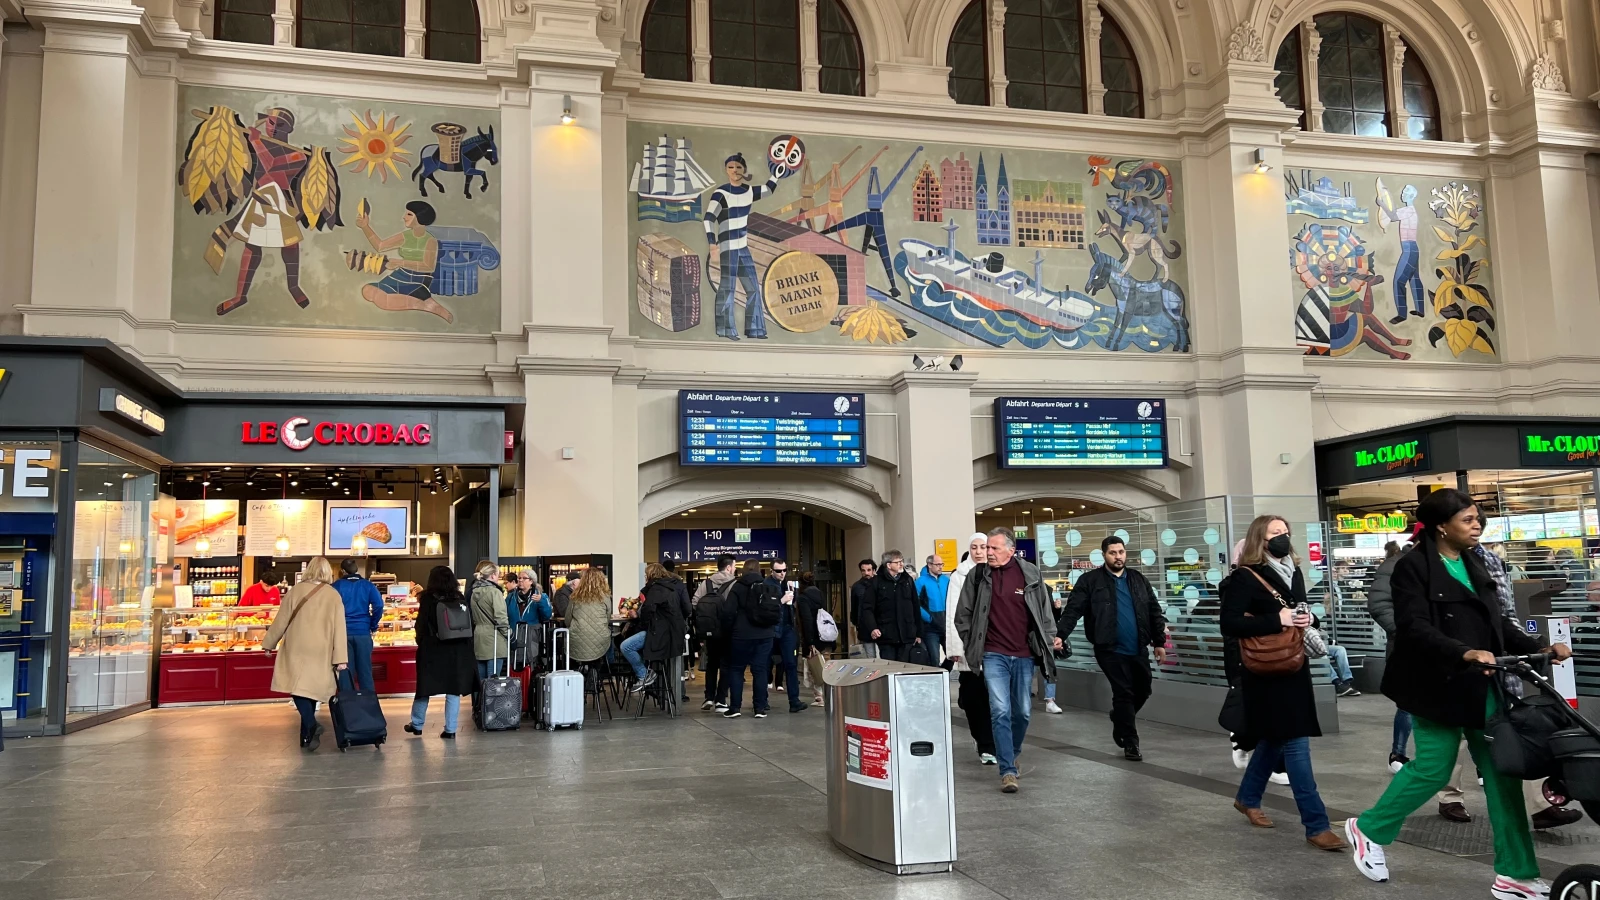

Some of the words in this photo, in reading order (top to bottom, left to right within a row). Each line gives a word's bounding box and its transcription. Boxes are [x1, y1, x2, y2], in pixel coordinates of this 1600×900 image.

[775, 271, 820, 290] BRINK
[779, 285, 822, 304] MANN
[786, 300, 822, 316] TABAK
[687, 393, 713, 401] Abfahrt
[240, 422, 278, 445] LE
[312, 421, 432, 447] CROBAG
[1526, 435, 1554, 453] Mr.
[1555, 435, 1600, 453] CLOU
[1355, 450, 1377, 467] Mr.
[1377, 440, 1419, 464] CLOU
[0, 447, 52, 499] E
[703, 530, 722, 540] 1-10
[868, 703, 880, 717] DB
